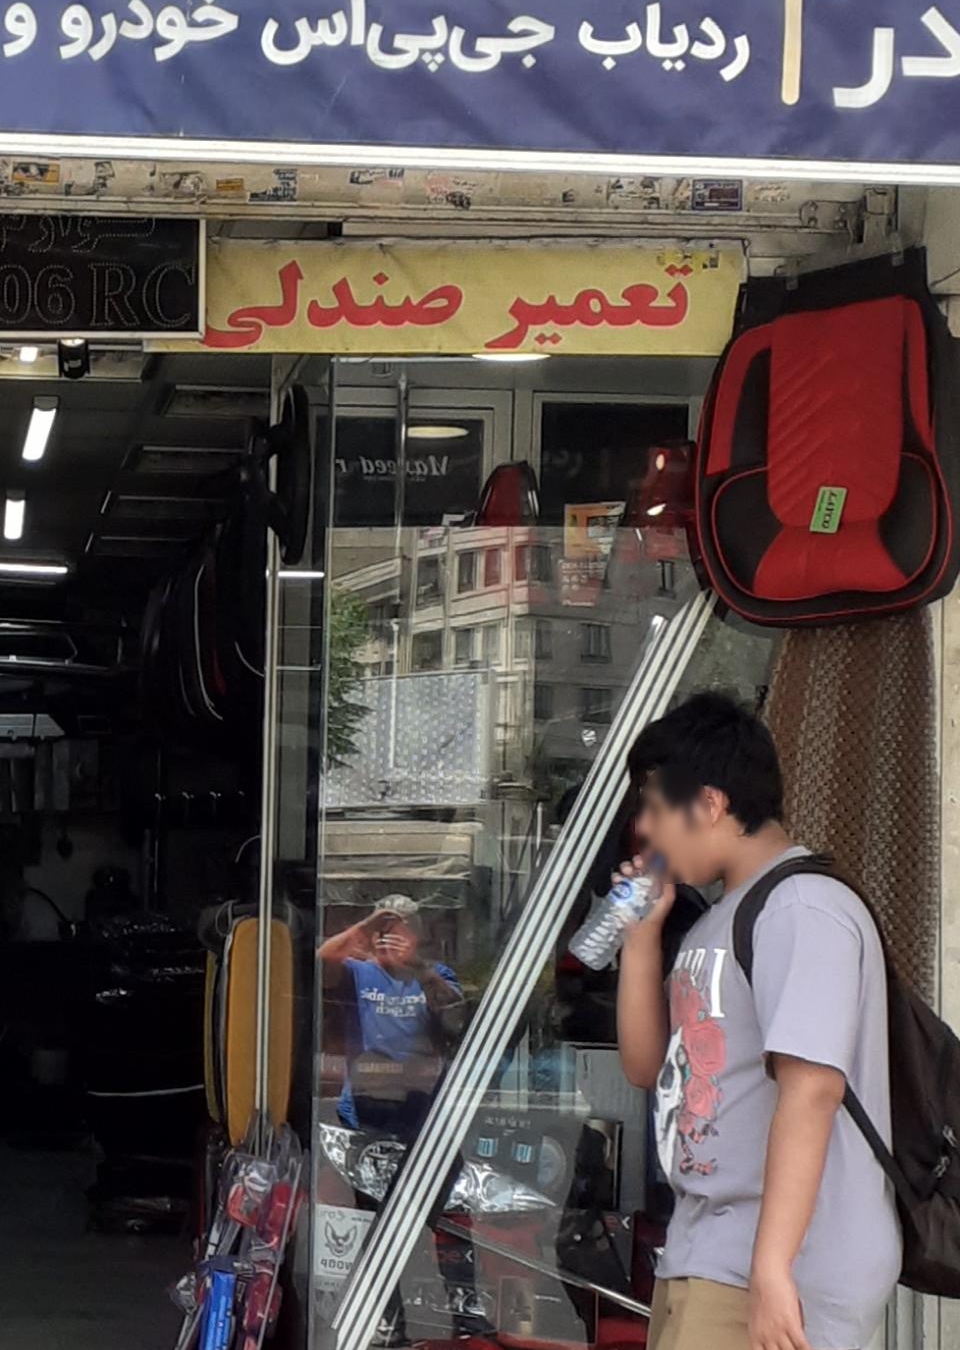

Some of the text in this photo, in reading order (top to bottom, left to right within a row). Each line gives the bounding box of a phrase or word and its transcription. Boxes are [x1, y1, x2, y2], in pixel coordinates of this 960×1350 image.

[2, 2, 38, 57] و
[578, 2, 750, 82] ردیاب
[88, 260, 197, 328] RC
[201, 260, 692, 350] تعمیر صندلی
